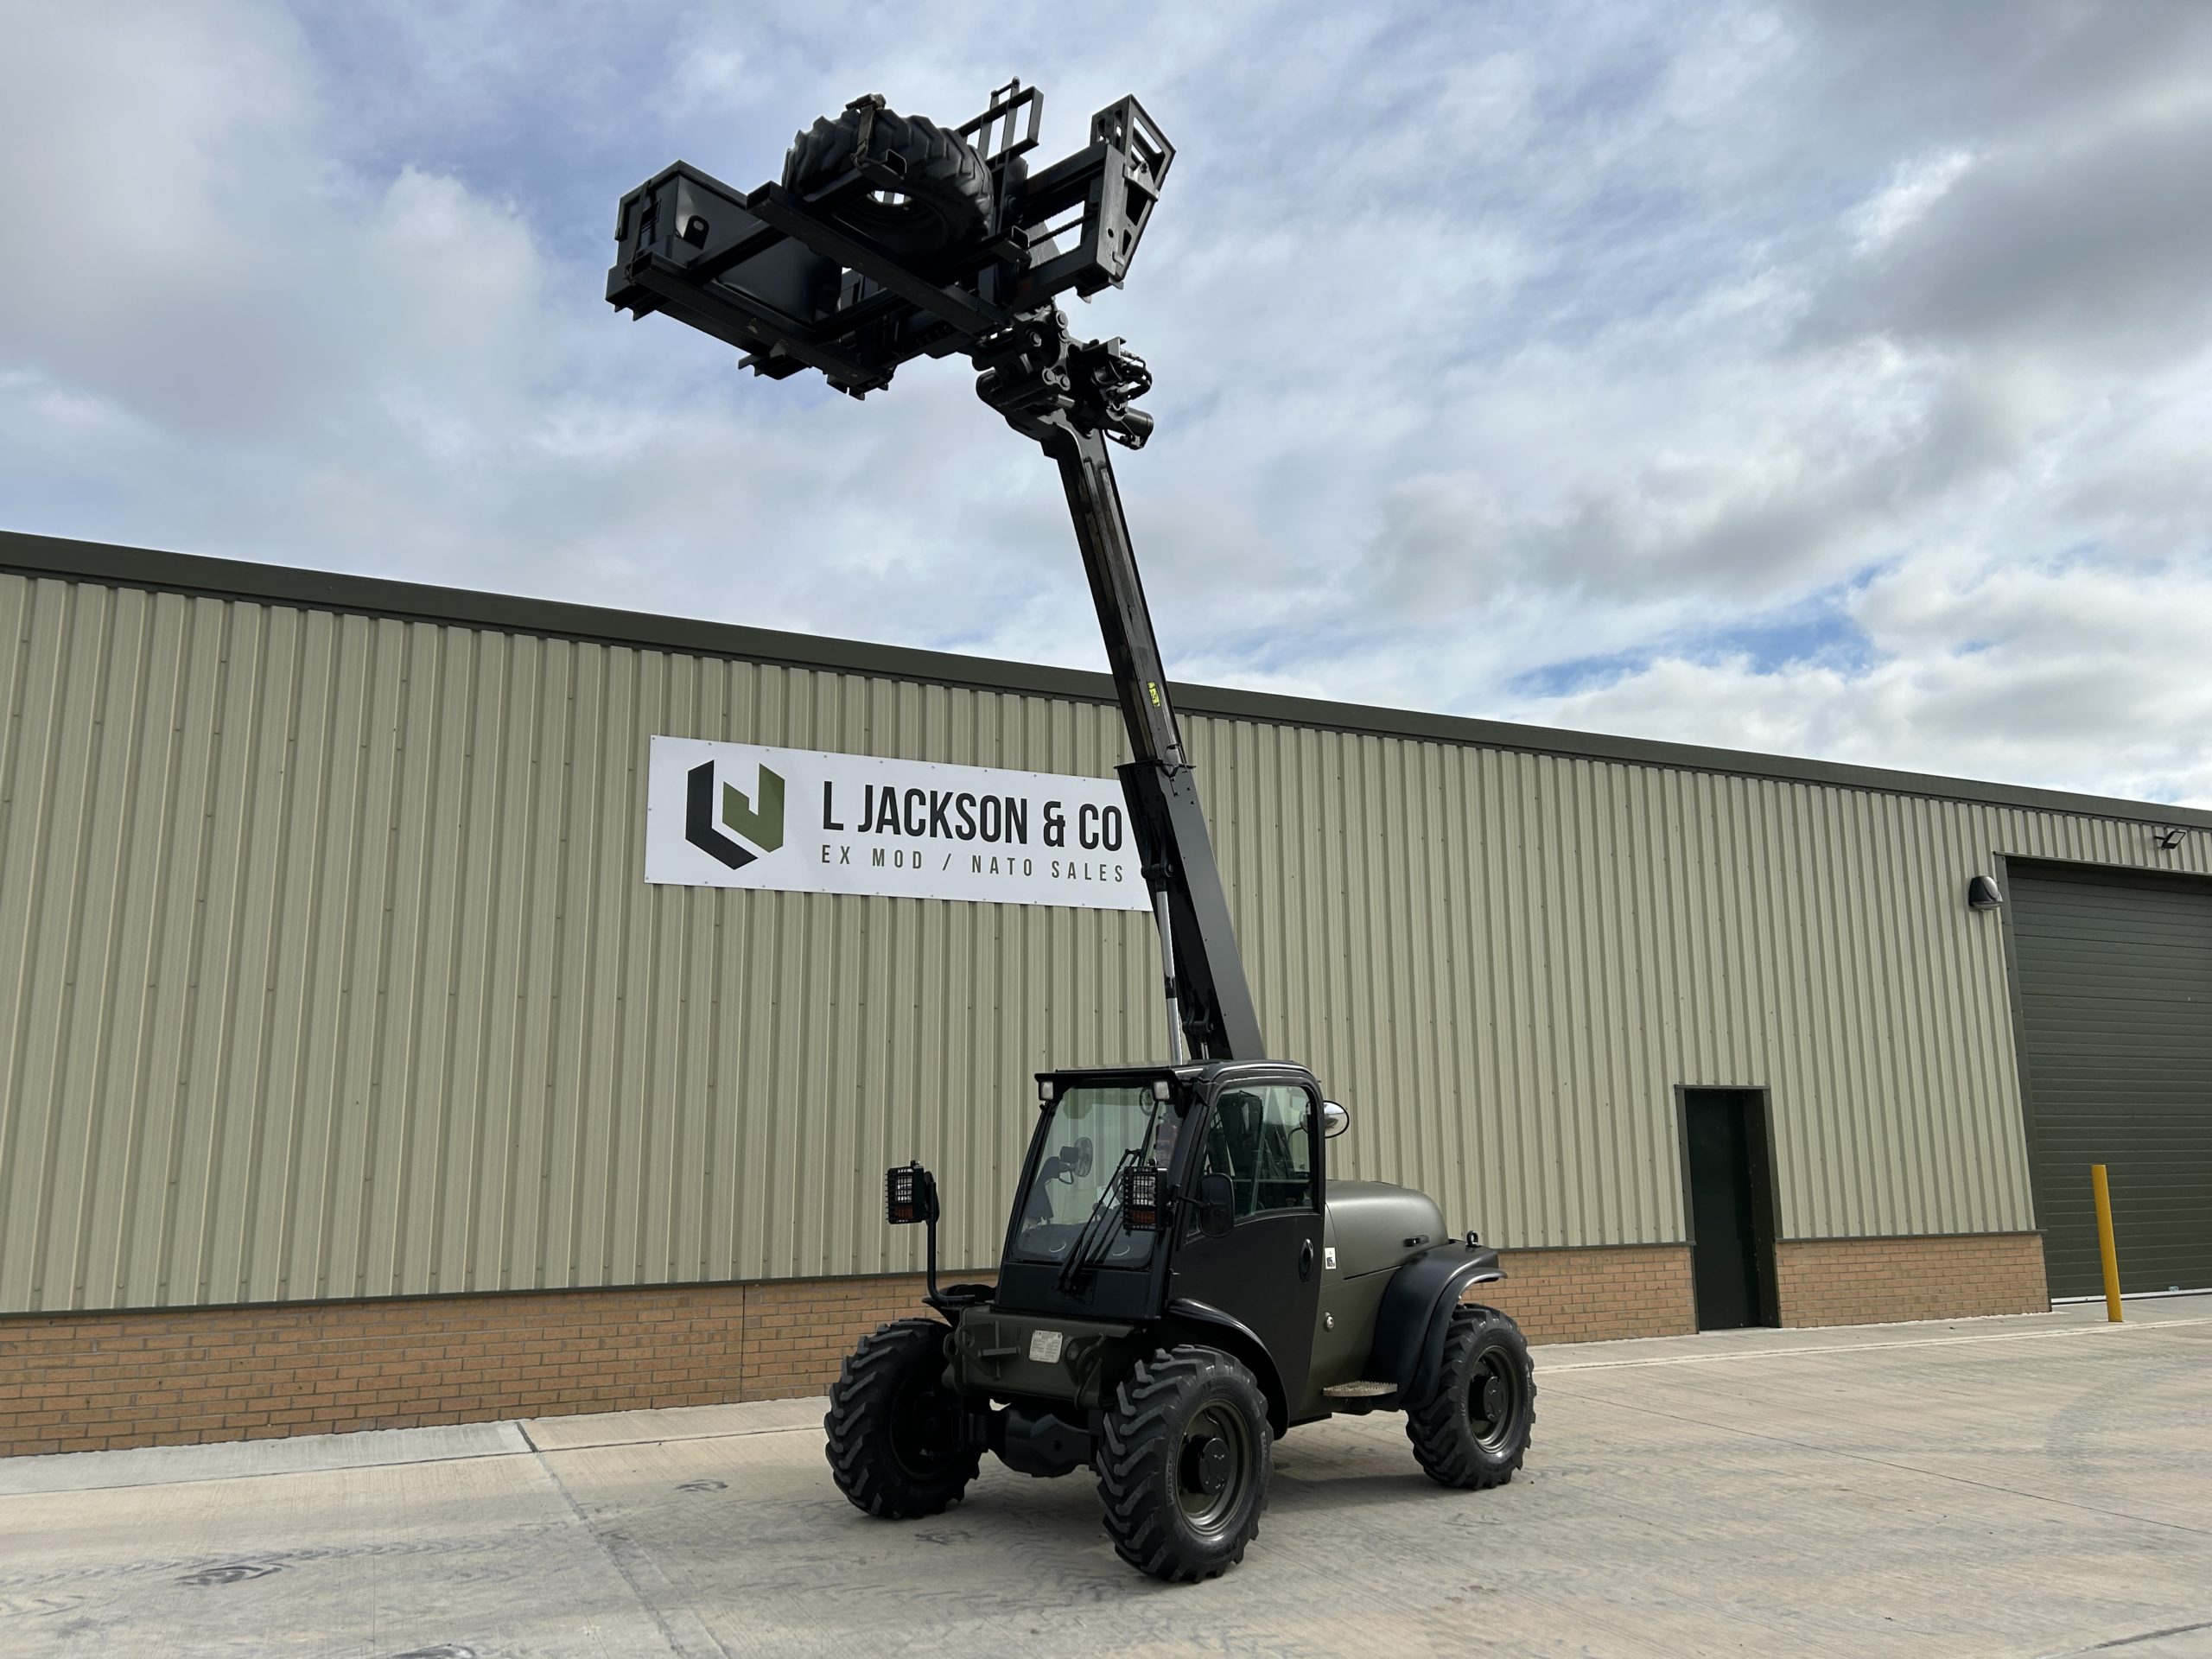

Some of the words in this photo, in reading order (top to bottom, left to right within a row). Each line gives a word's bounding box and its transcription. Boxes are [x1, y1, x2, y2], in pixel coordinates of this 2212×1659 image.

[823, 780, 844, 831] L
[857, 784, 1027, 845] JACKSON
[1043, 800, 1066, 848] &
[1078, 803, 1122, 852] CO
[821, 844, 850, 865] EX
[872, 848, 922, 869] MOD
[942, 853, 951, 871] /
[971, 855, 1033, 877] NATO
[1052, 860, 1123, 882] SALES
